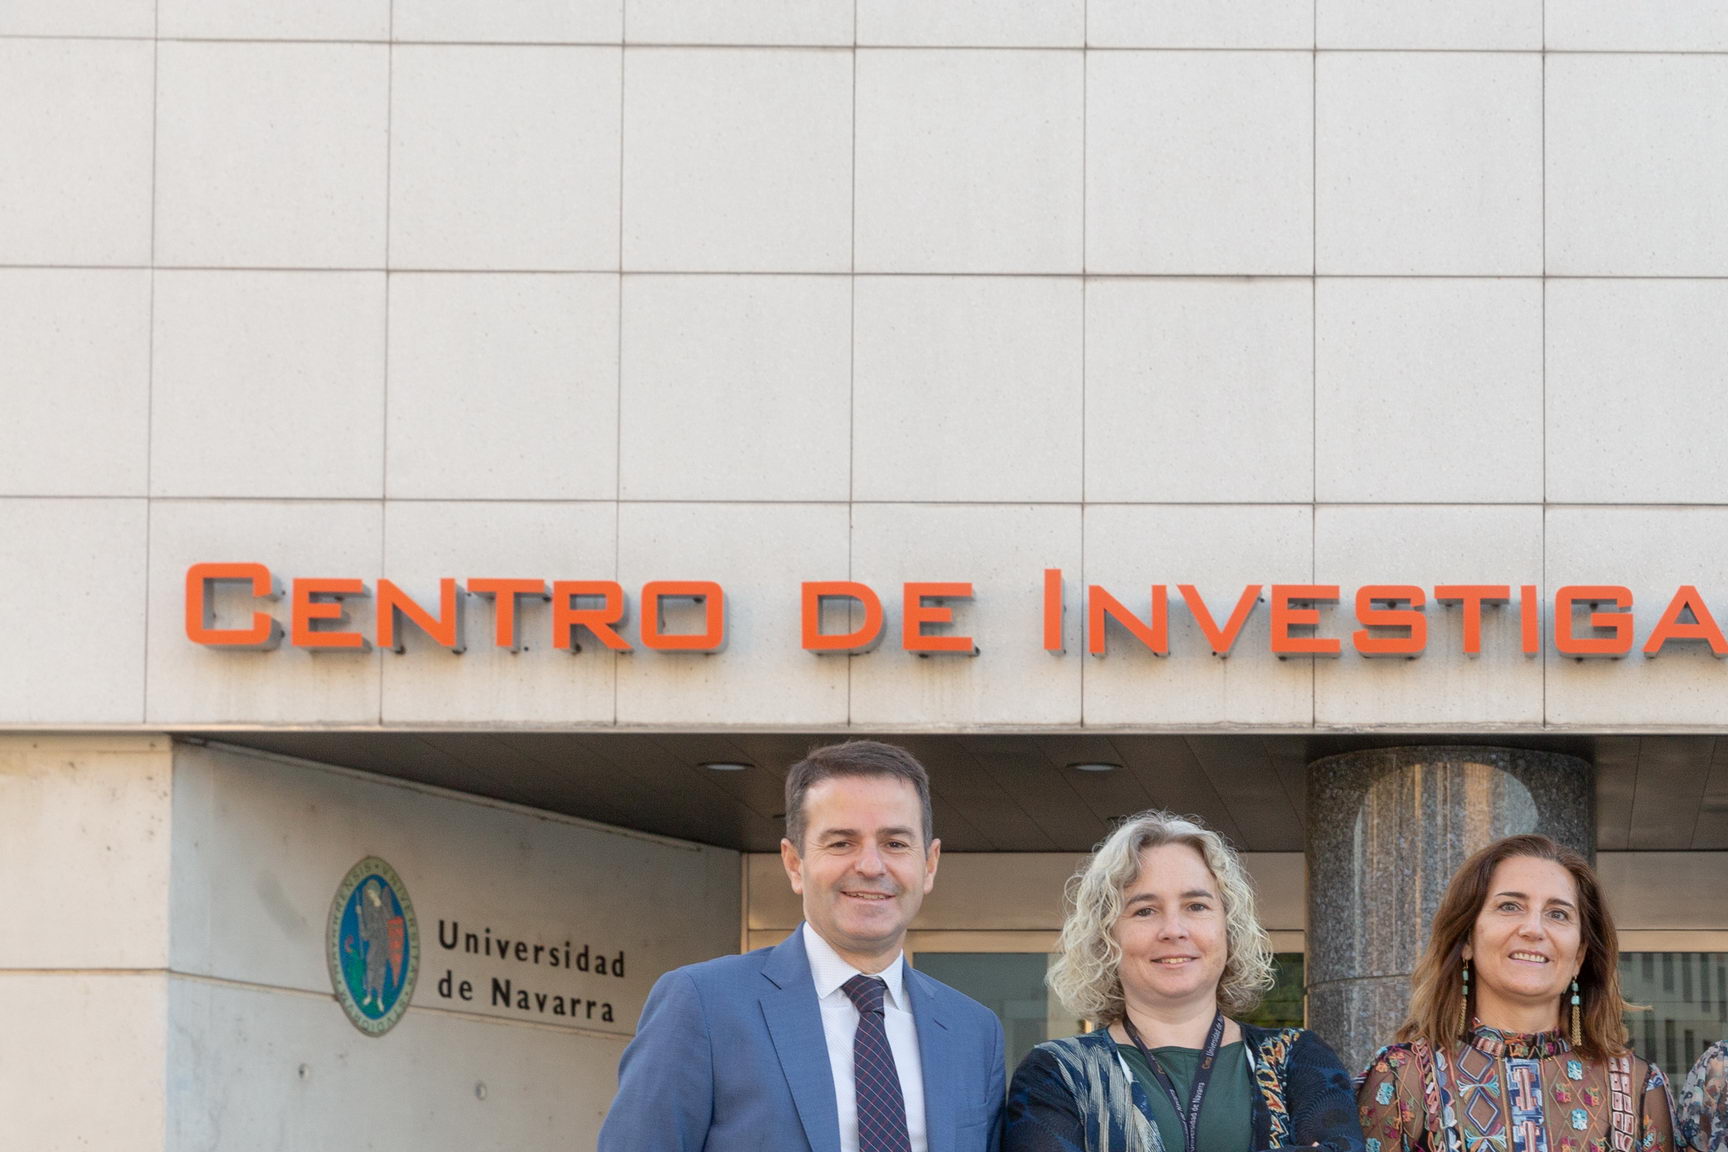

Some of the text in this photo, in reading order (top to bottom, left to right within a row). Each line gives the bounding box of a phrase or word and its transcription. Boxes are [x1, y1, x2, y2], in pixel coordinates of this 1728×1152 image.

[185, 562, 725, 651] CENTRO
[801, 581, 974, 652] DE
[438, 920, 625, 977] Universidad
[438, 970, 614, 1022] de Navarra
